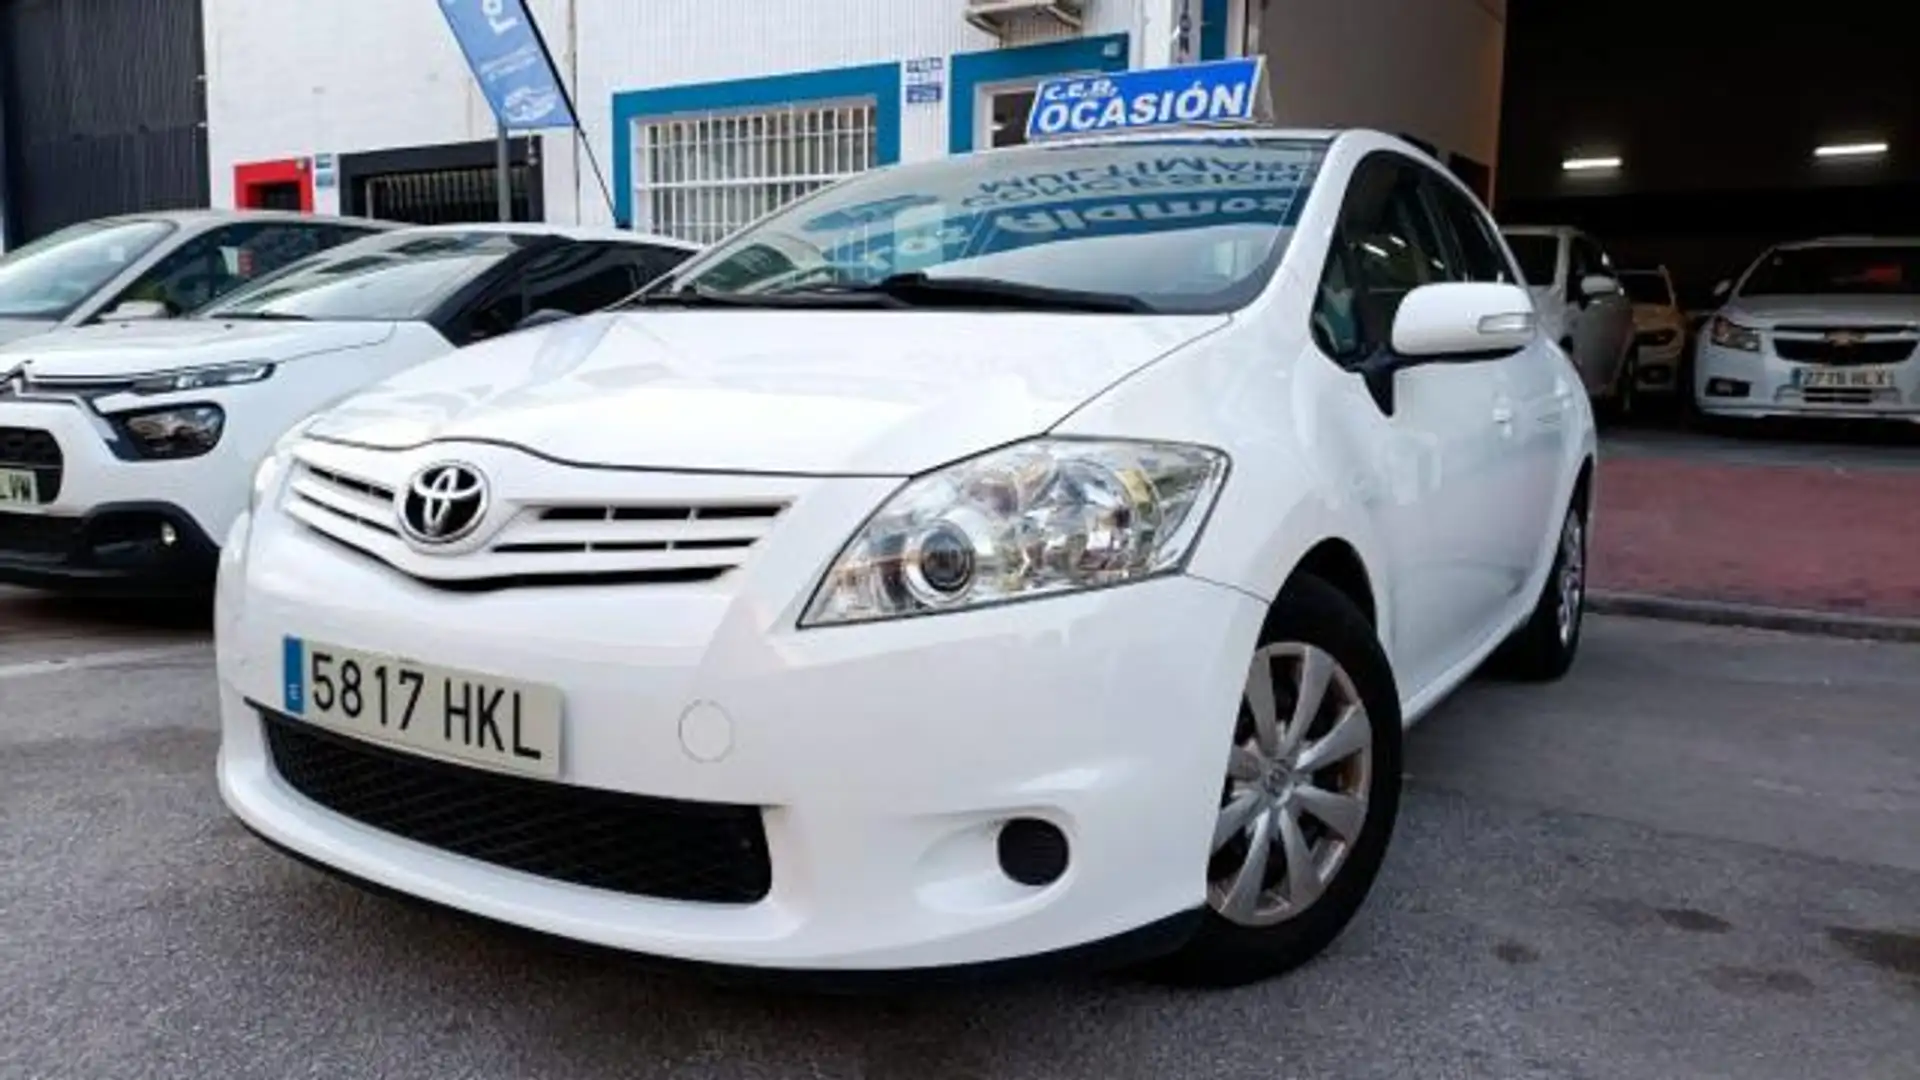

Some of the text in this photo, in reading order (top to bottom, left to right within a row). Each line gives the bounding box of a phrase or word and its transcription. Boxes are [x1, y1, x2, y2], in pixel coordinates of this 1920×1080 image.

[1038, 81, 1246, 133] OCASIÓN
[311, 651, 542, 760] 5817 HKL
